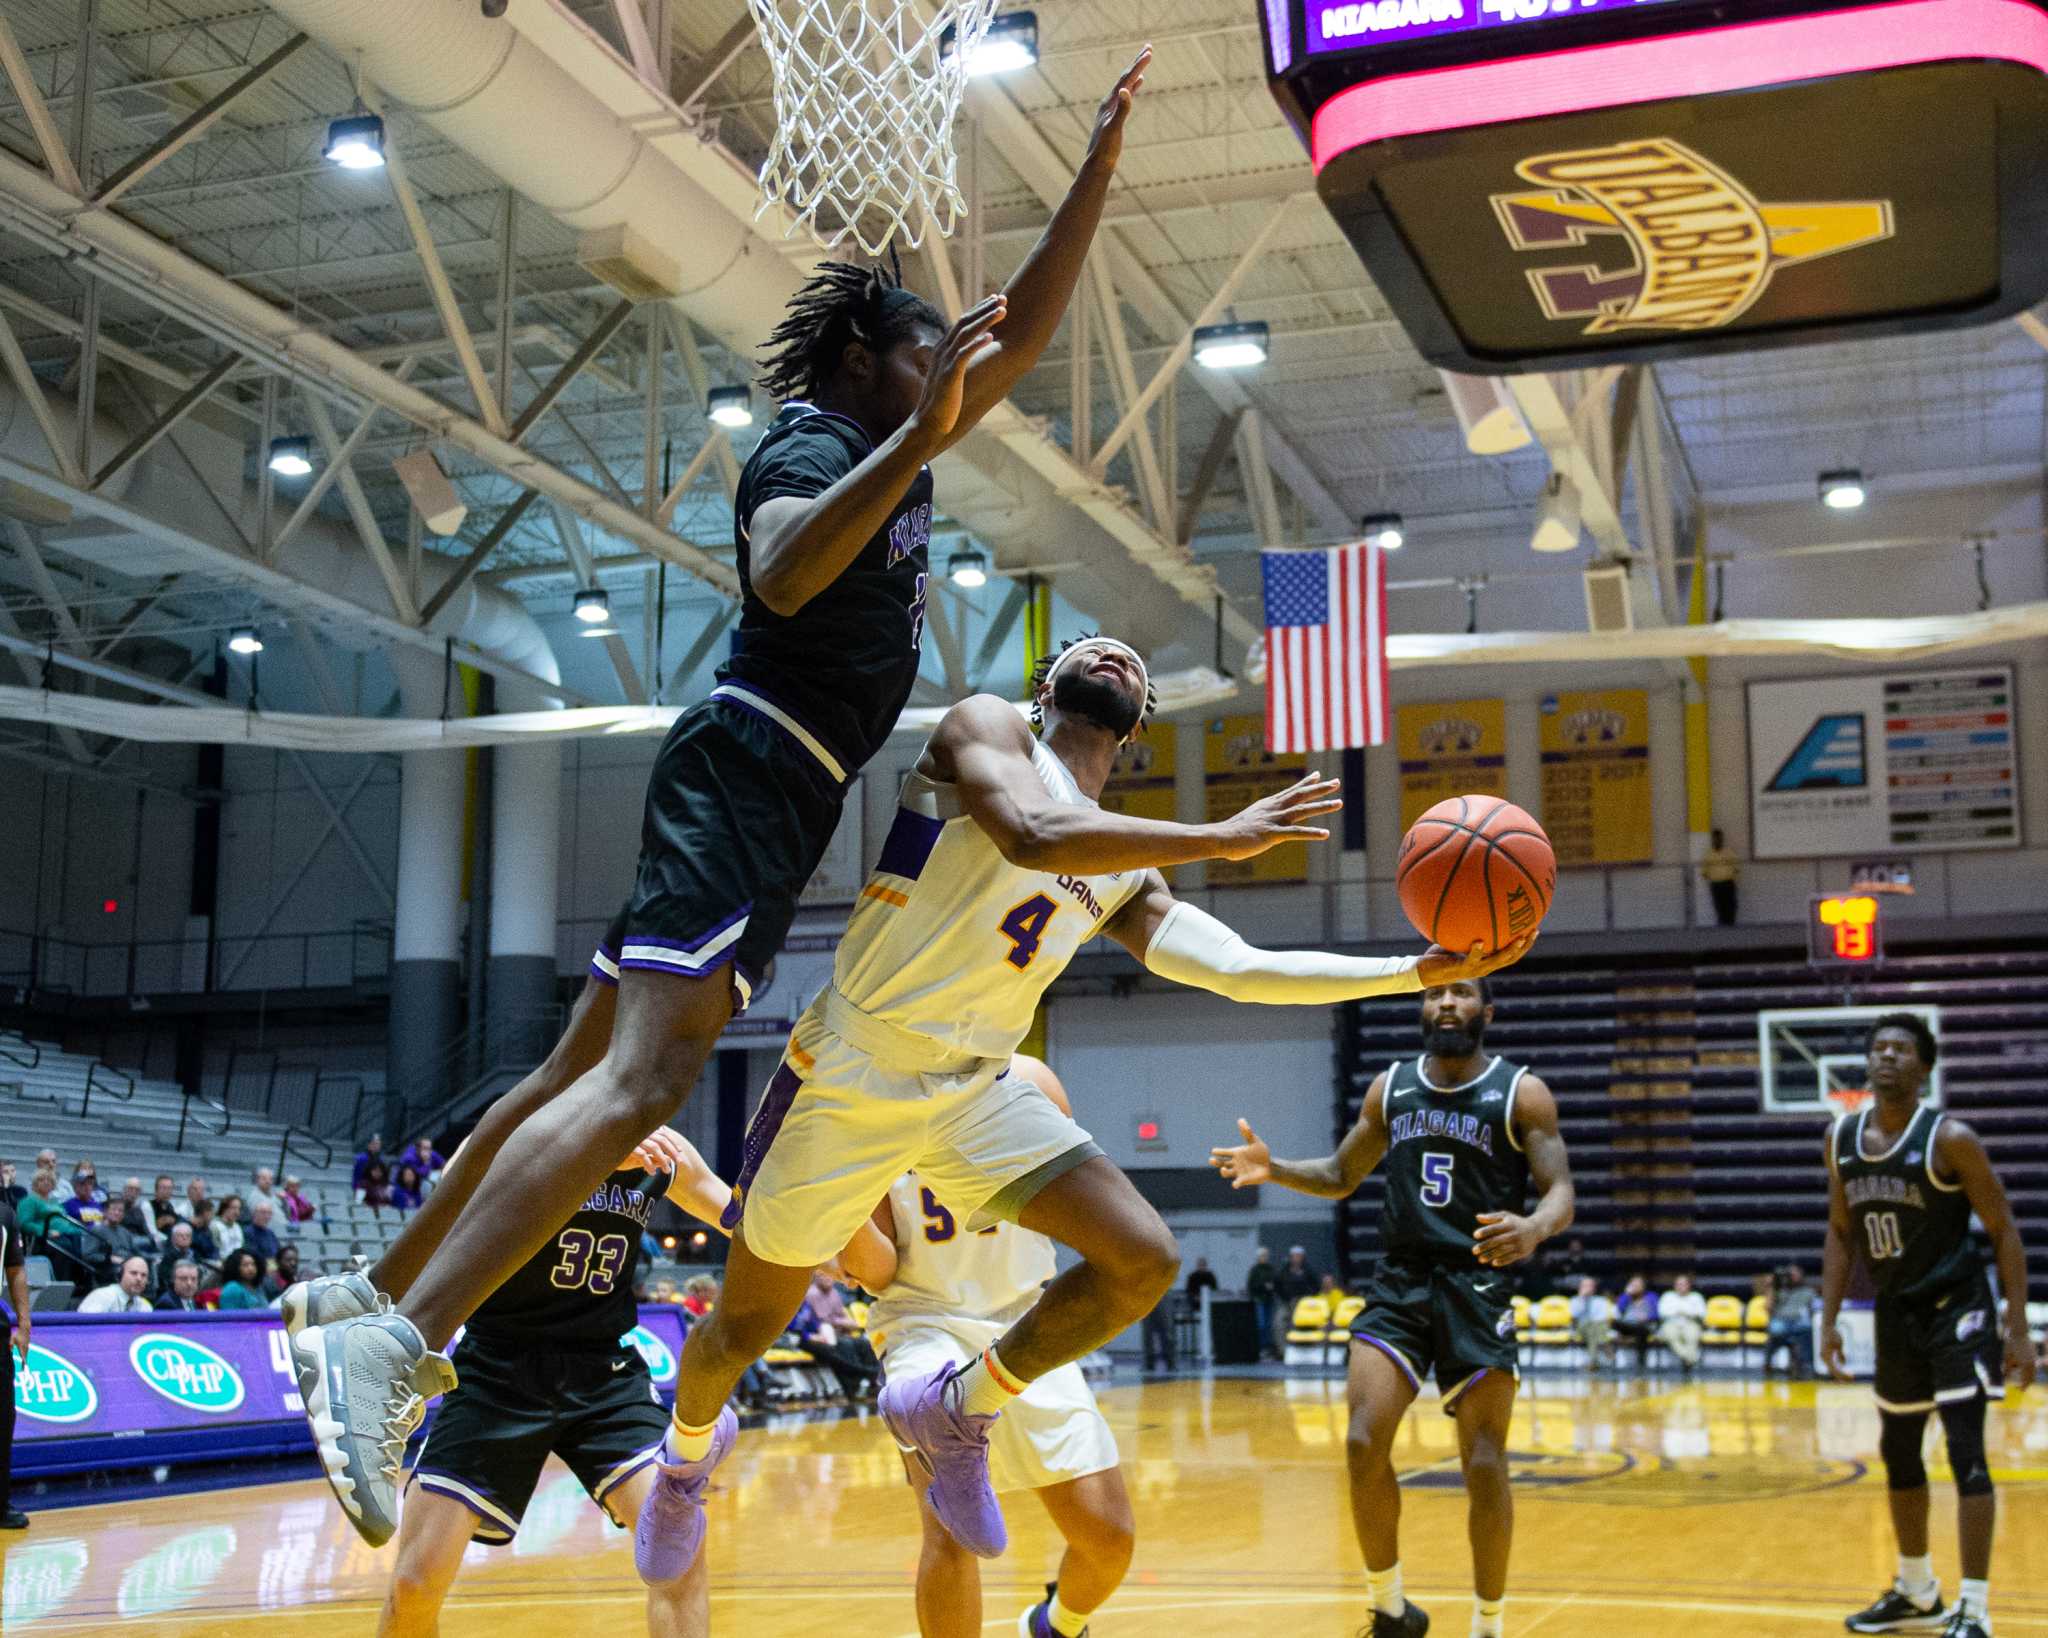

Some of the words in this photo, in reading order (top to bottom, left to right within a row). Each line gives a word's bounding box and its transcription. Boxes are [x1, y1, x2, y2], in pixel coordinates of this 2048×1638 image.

[997, 890, 1061, 974] 4
[1390, 1109, 1494, 1158] NIAGARA
[1420, 1152, 1454, 1207] 5
[1863, 1211, 1905, 1259] 11
[550, 1228, 629, 1295] 33
[146, 1349, 224, 1395] CDPHP
